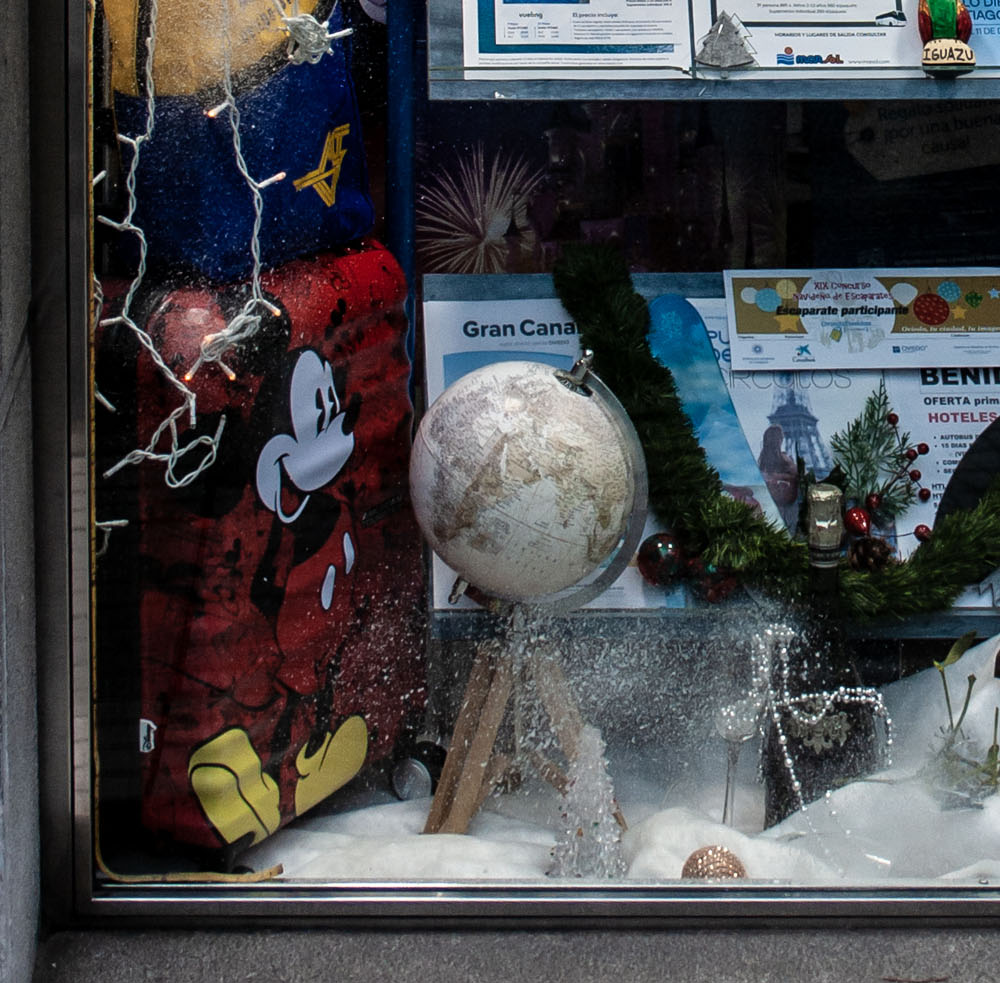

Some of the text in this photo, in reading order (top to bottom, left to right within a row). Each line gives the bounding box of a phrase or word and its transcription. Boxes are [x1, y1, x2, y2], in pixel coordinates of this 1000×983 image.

[922, 47, 974, 61] IGUAZU
[813, 281, 829, 290] XIX
[776, 304, 909, 317] Escaparate participante
[462, 319, 582, 337] Gran Cana
[923, 396, 971, 406] OFERTA
[928, 412, 998, 423] HOTELES
